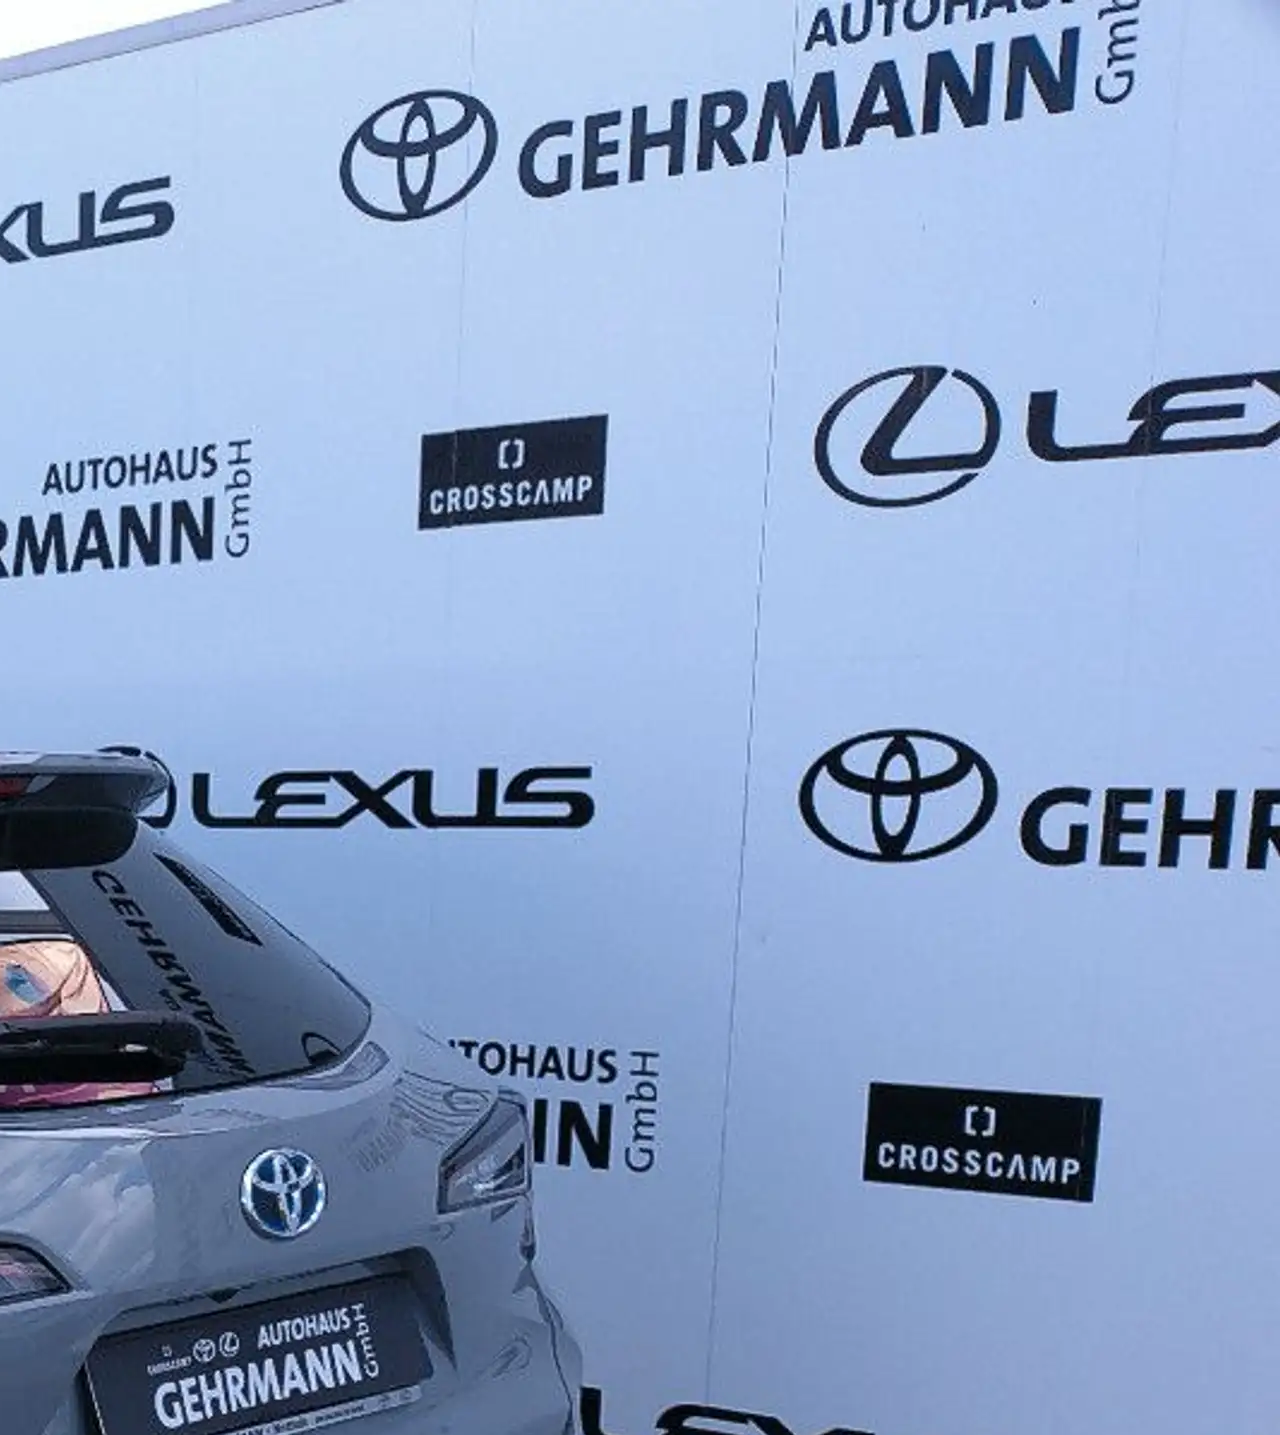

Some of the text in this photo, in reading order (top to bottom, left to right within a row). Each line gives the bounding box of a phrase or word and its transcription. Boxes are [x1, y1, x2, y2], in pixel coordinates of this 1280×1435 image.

[804, 0, 1078, 51] AUTOH
[1094, 0, 1141, 105] Gmb
[518, 26, 1081, 199] GEHRMANN
[41, 443, 218, 496] AUTOHAUS
[224, 439, 252, 558] GmbH
[428, 474, 594, 515] CROSSCAMP
[192, 766, 595, 829] LEXUS
[1020, 786, 1280, 870] GEHR
[449, 1039, 618, 1084] TOHAUS
[624, 1051, 660, 1173] GmbH
[877, 1141, 1080, 1185] CROSSCAMP
[257, 1306, 351, 1348] AUTOHAUS
[351, 1302, 379, 1379] GmbH
[154, 1339, 362, 1430] GEHRMANN
